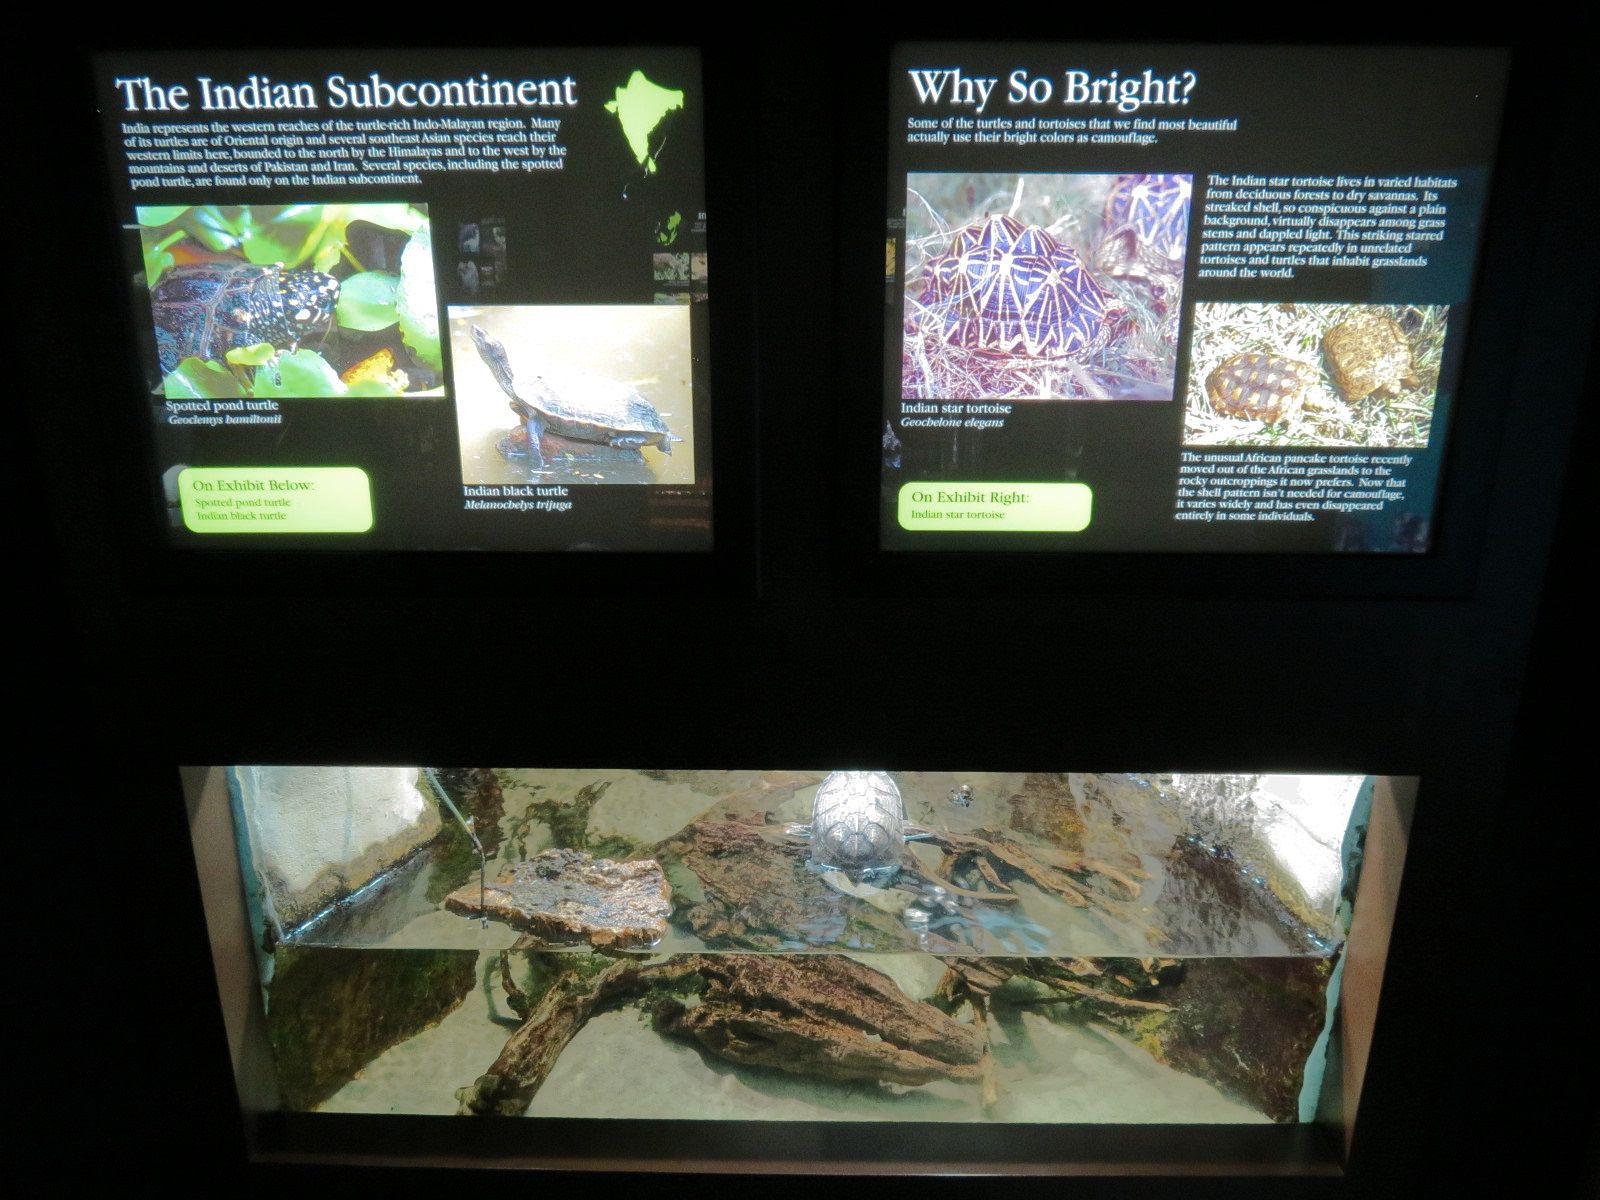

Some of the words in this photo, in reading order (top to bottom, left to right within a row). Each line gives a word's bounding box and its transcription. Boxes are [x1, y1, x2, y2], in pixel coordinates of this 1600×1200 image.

[115, 77, 189, 111] The
[198, 75, 318, 110] Indian
[327, 73, 578, 109] Subcontinent
[908, 68, 997, 113] Why
[1008, 70, 1052, 104] So
[1064, 68, 1196, 112] Bright?
[122, 122, 150, 133] India
[153, 123, 209, 136] represents
[212, 120, 229, 132] the
[232, 122, 275, 131] western
[278, 120, 318, 131] reaches
[321, 119, 333, 130] of
[336, 119, 353, 130] the
[356, 118, 410, 130] turtle-rich
[413, 118, 485, 132] Indo-Malayan
[488, 117, 526, 132] region.
[531, 117, 560, 131] Many
[908, 117, 938, 128] Some
[942, 118, 952, 128] of
[956, 118, 974, 128] the
[977, 118, 1012, 129] turtles
[1015, 118, 1035, 129] and
[1038, 118, 1086, 129] tortoises
[1089, 118, 1110, 129] that
[1114, 121, 1130, 129] we
[1133, 119, 1155, 130] find
[1159, 120, 1184, 130] most
[1188, 119, 1237, 130] beautiful
[125, 135, 137, 146] of
[139, 135, 151, 146] its
[154, 135, 189, 146] turtles
[192, 137, 208, 146] are
[211, 134, 222, 145] of
[224, 134, 269, 145] Oriental
[272, 133, 304, 148] origin
[307, 133, 326, 144] and
[330, 133, 366, 144] several
[369, 132, 419, 143] southeast
[422, 132, 451, 143] Asian
[454, 131, 494, 146] species
[497, 131, 527, 142] reach
[530, 130, 556, 142] their
[908, 131, 949, 145] actually
[953, 134, 971, 142] use
[975, 131, 1000, 142] their
[1004, 132, 1037, 145] bright
[1040, 132, 1074, 142] colors
[1078, 135, 1088, 143] as
[1092, 132, 1157, 146] camouflage.
[129, 162, 185, 173] mountains
[188, 161, 207, 172] and
[210, 161, 248, 172] deserts
[251, 160, 262, 172] of
[264, 160, 308, 171] Pakistan
[311, 159, 331, 171] and
[334, 159, 358, 170] Iran.
[363, 159, 400, 170] Several
[403, 158, 446, 173] species,
[448, 158, 499, 172] including
[502, 158, 519, 169] the
[522, 157, 563, 172] spotted
[131, 175, 159, 189] pond
[162, 174, 194, 188] turtle,
[196, 177, 212, 185] are
[215, 174, 246, 185] found
[249, 173, 271, 188] only
[275, 176, 289, 184] on
[292, 173, 309, 184] the
[312, 173, 346, 184] Indian
[349, 172, 422, 183] subcontinent.
[1208, 174, 1229, 185] The
[1232, 174, 1265, 185] Indian
[1269, 176, 1289, 186] star
[1292, 175, 1334, 186] tortoise
[1337, 176, 1361, 186] lives
[1364, 176, 1375, 186] in
[1378, 176, 1411, 187] varied
[1414, 176, 1457, 187] habitats
[1204, 214, 1270, 228] background,
[1273, 215, 1316, 228] virtually
[1319, 215, 1376, 229] disappears
[1379, 218, 1415, 230] among
[1418, 219, 1446, 230] grass
[1202, 228, 1234, 238] stems
[1236, 227, 1256, 238] and
[1259, 228, 1302, 242] dappled
[1306, 228, 1332, 242] light.
[1336, 228, 1359, 239] This
[1362, 229, 1403, 242] striking
[1406, 229, 1443, 240] starred
[1200, 253, 1246, 264] tortoises
[1249, 253, 1269, 264] and
[1272, 254, 1306, 264] turtles
[1308, 254, 1329, 265] that
[1332, 254, 1369, 265] inhabit
[1372, 255, 1427, 268] grasslands
[1199, 266, 1236, 277] around
[1239, 266, 1257, 277] the
[1261, 266, 1294, 277] world.
[166, 401, 210, 413] Spotted
[214, 401, 244, 413] pond
[247, 400, 279, 410] turtle
[901, 403, 938, 413] Indian
[942, 404, 963, 413] star
[967, 403, 1012, 414] tortoise
[964, 418, 1004, 429] elegans
[1181, 451, 1202, 462] The
[1204, 451, 1244, 462] unusual
[1245, 452, 1281, 462] African
[1284, 452, 1327, 465] pancake
[1330, 452, 1368, 463] tortoise
[1371, 452, 1412, 466] recently
[1180, 463, 1215, 473] moved
[1218, 464, 1234, 474] out
[1237, 463, 1248, 474] of
[1251, 463, 1266, 474] the
[1268, 463, 1304, 474] African
[1307, 464, 1359, 477] grasslands
[1361, 466, 1372, 475] to
[1375, 464, 1392, 475] the
[193, 480, 212, 491] On
[218, 480, 264, 490] Exhibit
[270, 480, 315, 490] Below:
[463, 486, 500, 496] Indian
[503, 486, 533, 496] black
[537, 486, 568, 496] turtle
[912, 492, 932, 502] On
[938, 492, 984, 503] Exhibit
[991, 492, 1029, 505] Right:
[1178, 486, 1195, 496] the
[1198, 486, 1221, 497] shell
[1223, 488, 1260, 500] pattern
[1263, 487, 1284, 497] isn't
[1287, 487, 1324, 498] needed
[1327, 487, 1341, 498] for
[1344, 488, 1404, 501] camouflage,
[196, 499, 232, 509] Spotted
[236, 499, 261, 508] pond
[537, 500, 572, 511] trijuga
[198, 512, 228, 520] Indian
[231, 512, 256, 520] black
[260, 512, 286, 520] turtle
[912, 510, 943, 519] Indian
[946, 511, 963, 519] star
[967, 511, 1005, 519] tortoise
